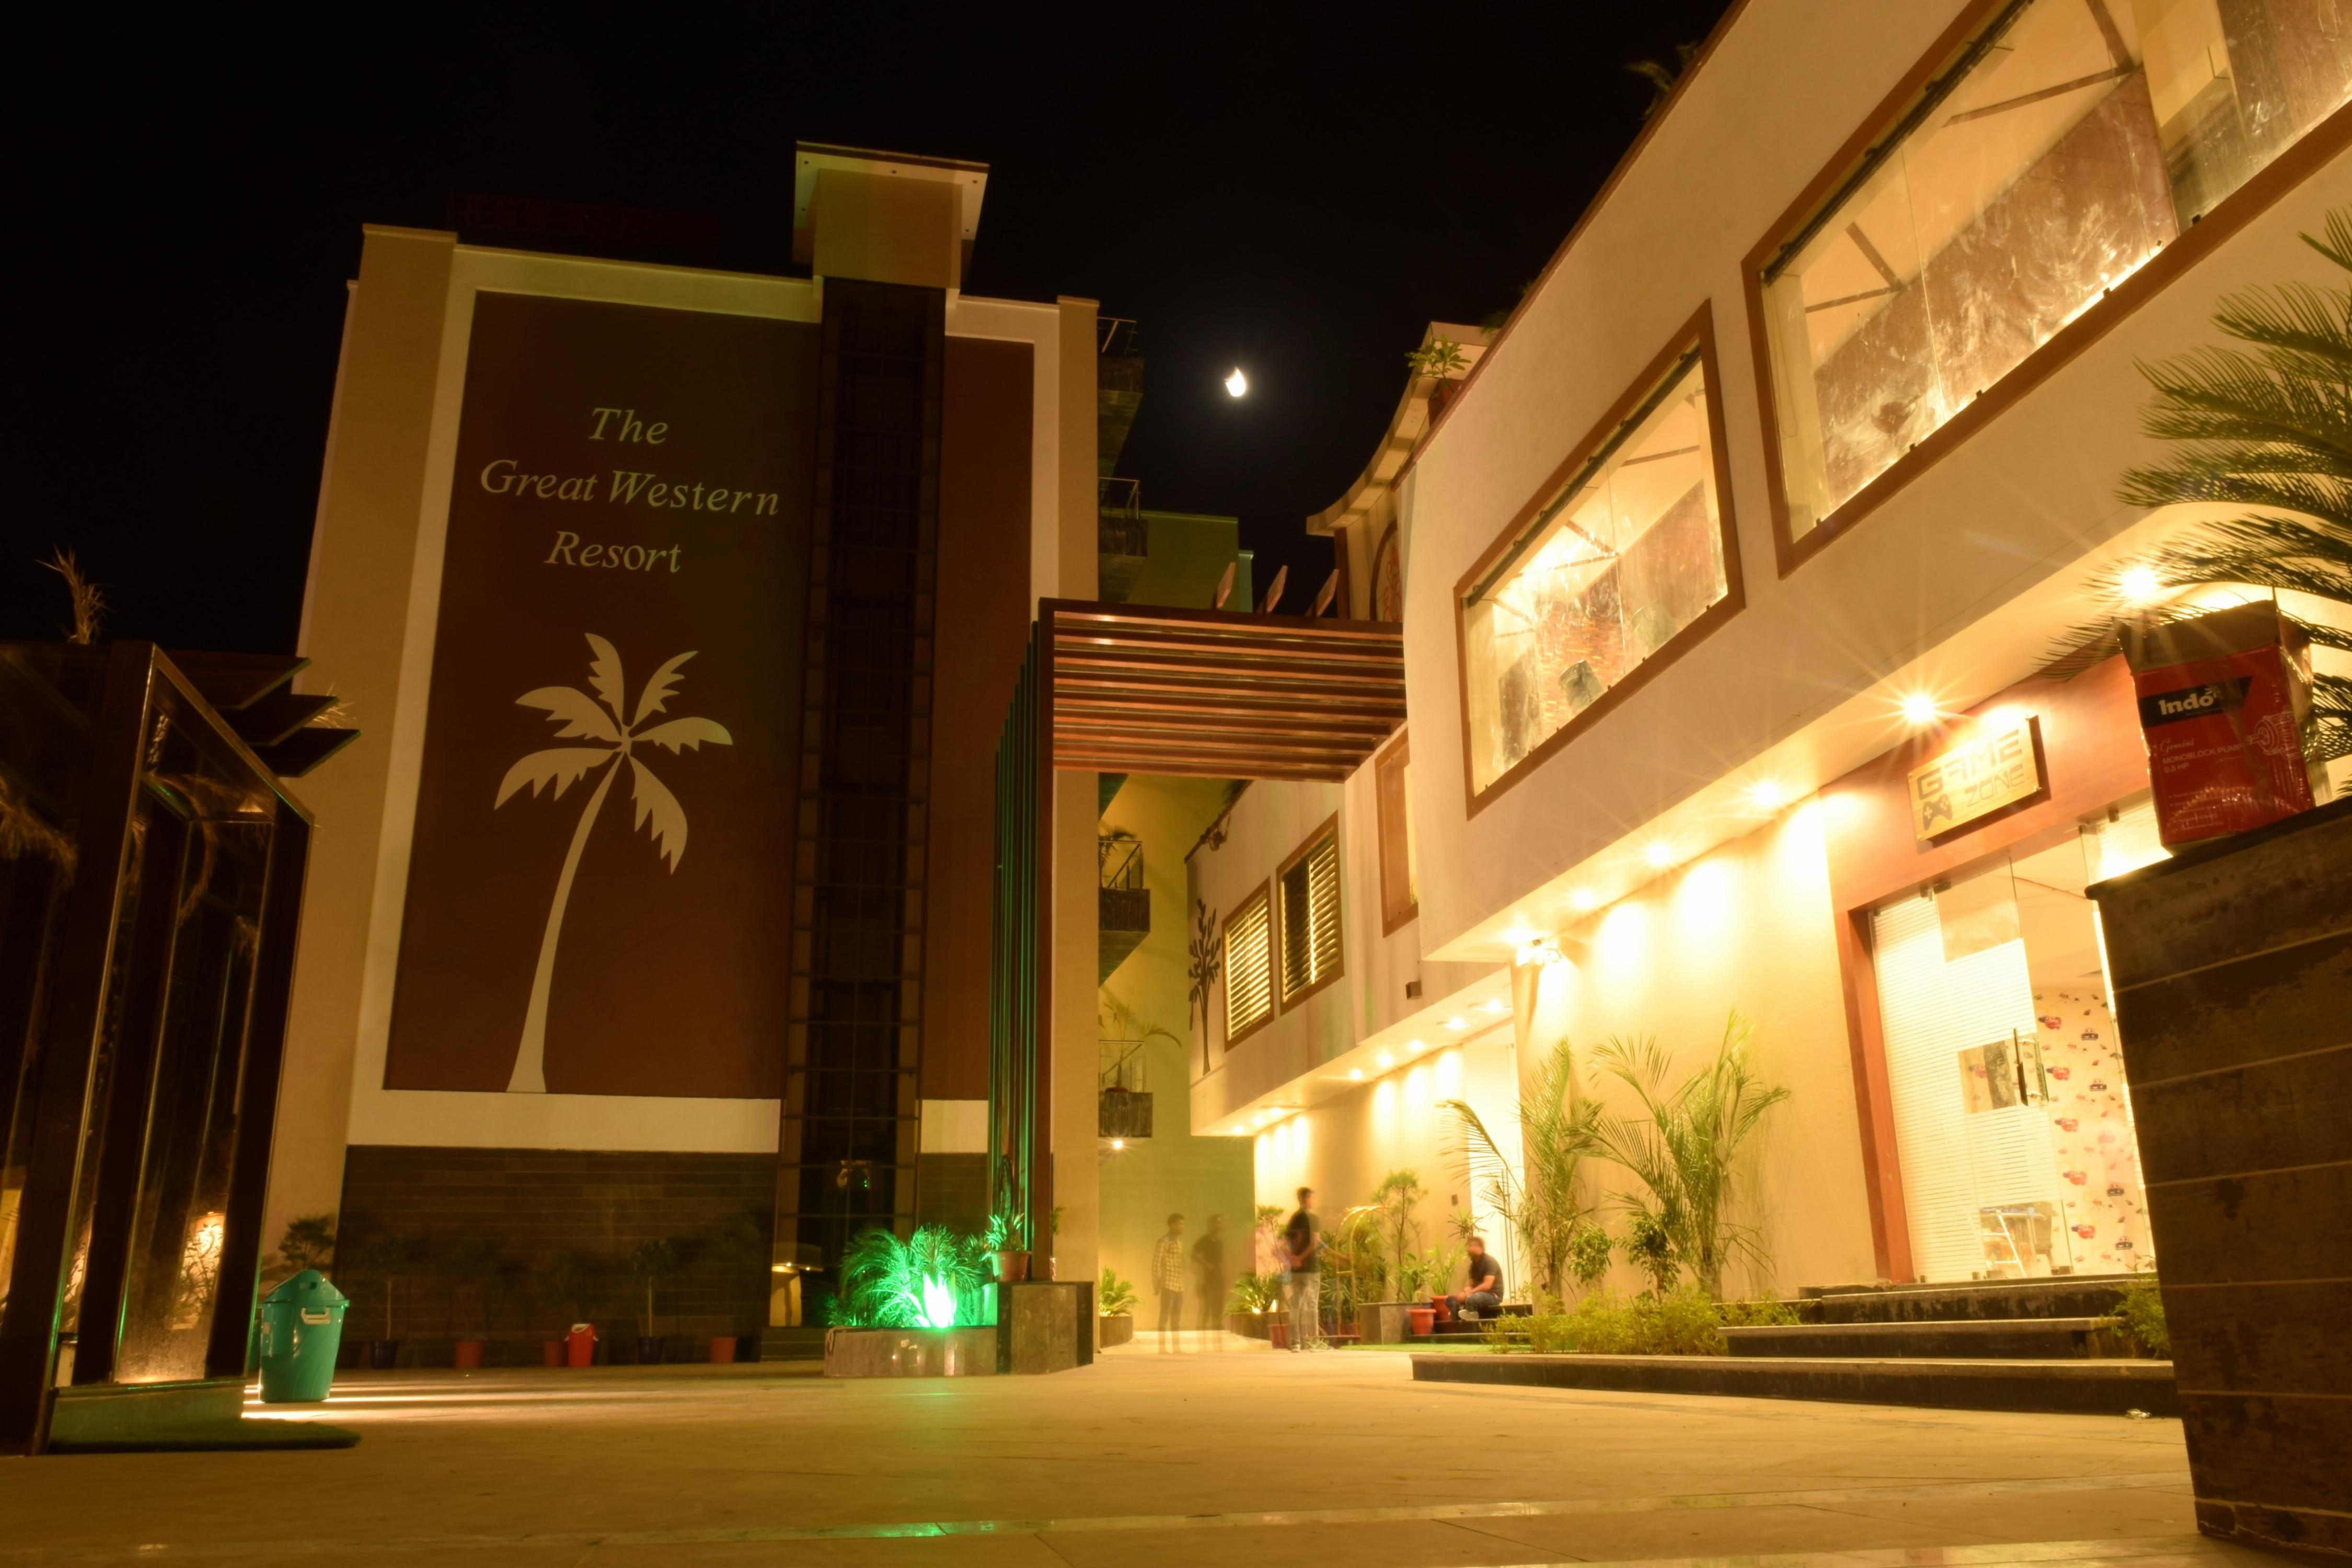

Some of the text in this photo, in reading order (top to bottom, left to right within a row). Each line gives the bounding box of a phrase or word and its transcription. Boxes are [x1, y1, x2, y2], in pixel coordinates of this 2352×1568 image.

[588, 407, 668, 444] The
[480, 459, 779, 516] Great Western
[544, 530, 682, 573] Resort
[2158, 693, 2214, 715] Indo
[1917, 729, 2022, 800] GAME
[2163, 743, 2242, 764] MONOBLOCK PUMP
[1964, 763, 2025, 808] ZONE
